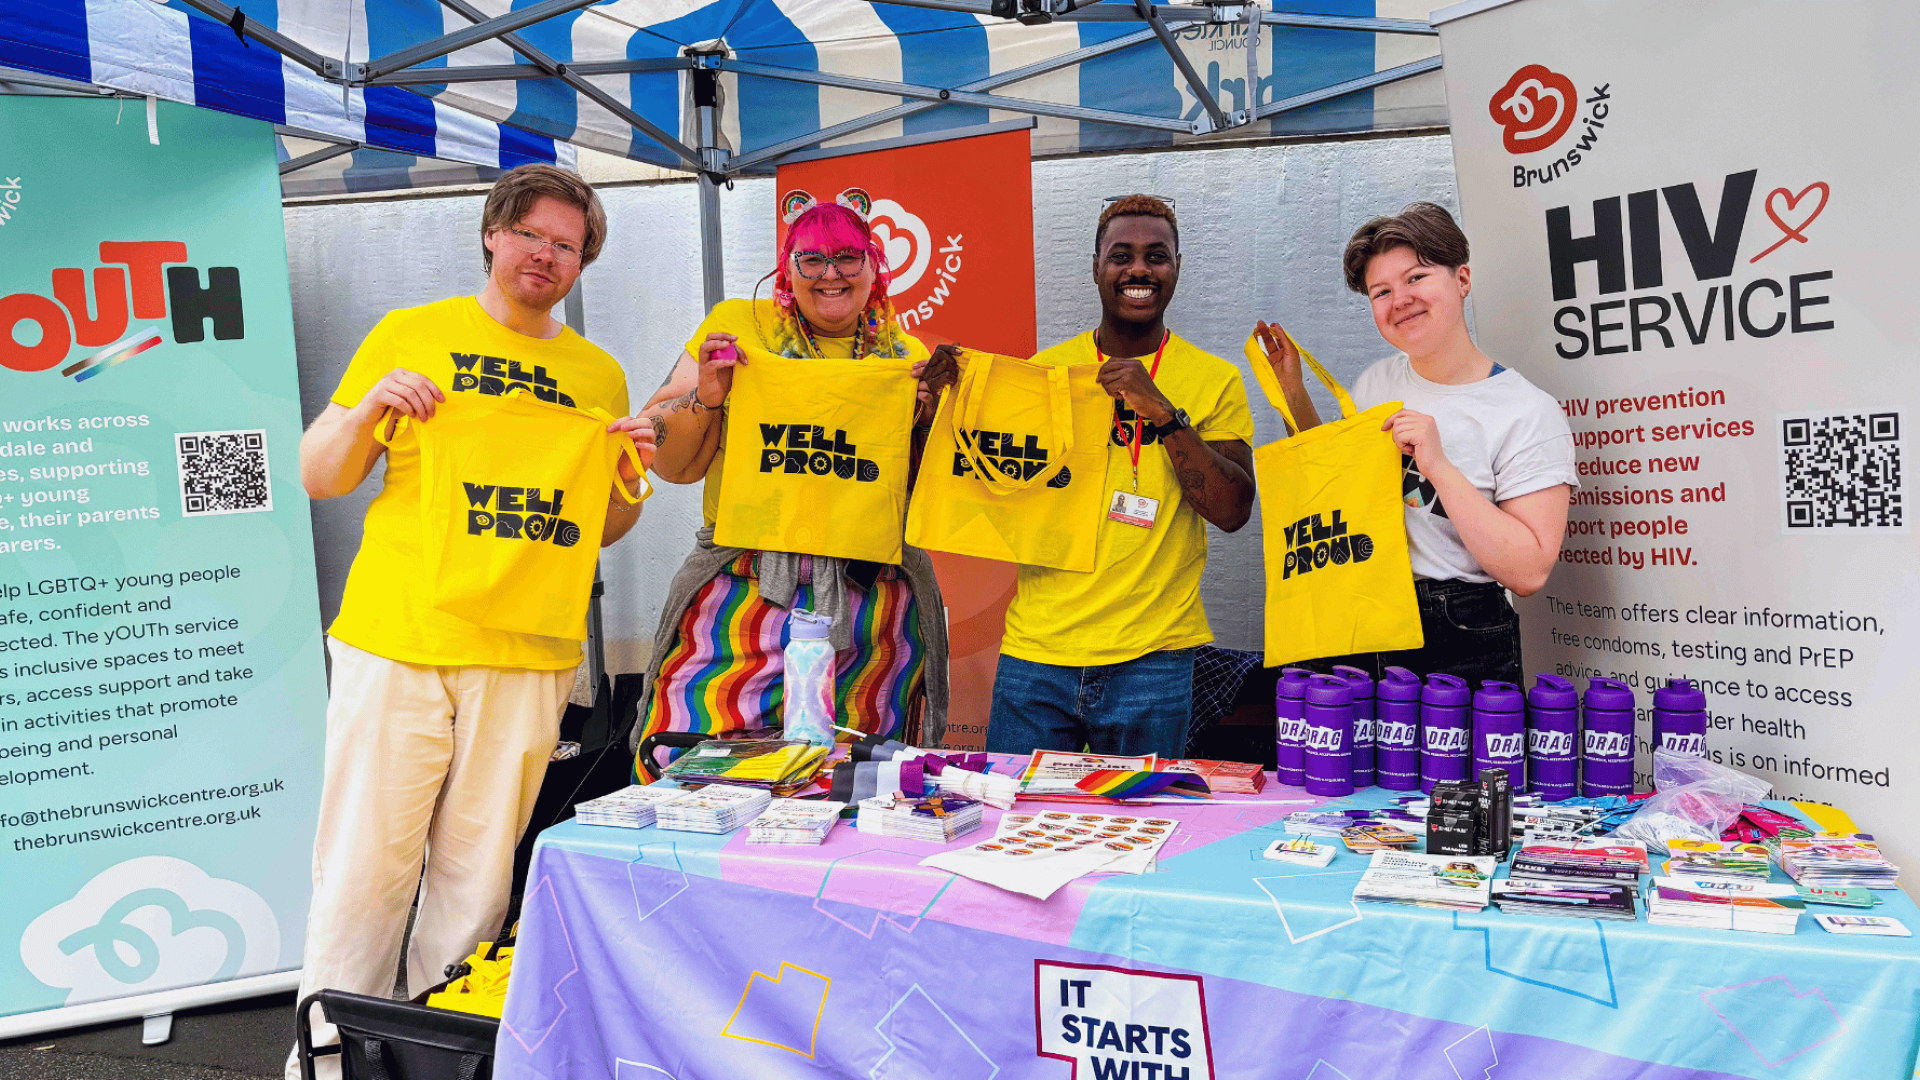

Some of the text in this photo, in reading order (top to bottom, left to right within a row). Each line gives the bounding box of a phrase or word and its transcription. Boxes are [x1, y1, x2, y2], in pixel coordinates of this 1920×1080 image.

[1512, 82, 1611, 188] Brunswick
[1545, 168, 1758, 302] HIV
[1552, 270, 1836, 360] SERVICE
[449, 352, 558, 390] WELL
[1557, 387, 1726, 419] HIV prevention
[2, 413, 150, 433] works across
[1572, 418, 1755, 451] upport services
[51, 438, 93, 455] and
[759, 423, 857, 457] WELL
[29, 459, 150, 481] supporting
[759, 448, 880, 483] PROUD
[1573, 452, 1700, 478] educe new
[21, 487, 91, 507] young
[462, 482, 565, 516] WELL
[1680, 482, 1726, 504] and
[18, 509, 72, 528] their
[77, 506, 161, 527] parents
[467, 510, 581, 548] PROUD
[1283, 509, 1348, 551] WELL
[1610, 515, 1689, 539] people
[1283, 533, 1374, 580] PROUD
[1617, 547, 1645, 570] by
[1651, 547, 1698, 567] HIV.
[27, 575, 109, 597] LGBTQ+
[115, 571, 174, 592] young
[179, 564, 241, 584] people
[38, 600, 132, 622] confident
[137, 596, 172, 612] and
[1546, 595, 1886, 636] The team offers clear information,
[62, 631, 99, 646] The
[104, 623, 169, 646] yOUTh
[174, 617, 240, 635] service
[14, 658, 98, 679] inclusive
[104, 651, 169, 670] spaces
[173, 647, 193, 661] to
[198, 641, 245, 659] meet
[1550, 628, 1854, 670] free condoms, testing and PrEP
[26, 684, 94, 703] access
[98, 674, 172, 695] support
[177, 669, 210, 687] and
[215, 664, 254, 683] take
[1609, 666, 1640, 688] and
[1645, 671, 1741, 700] guance
[1747, 678, 1769, 699] to
[1774, 684, 1853, 708] access
[1, 694, 239, 733] in activities that promote
[1281, 721, 1307, 738] DRA
[1740, 713, 1807, 741] health
[58, 735, 93, 753] and
[98, 725, 179, 751] personal
[1530, 732, 1573, 751] DRAG
[1586, 733, 1630, 751] DRAG
[1730, 748, 1746, 768] is
[1753, 757, 1777, 773] on
[1784, 759, 1891, 788] informed
[13, 805, 262, 852] thebrunswickcentre.org.uk
[1060, 978, 1092, 1008] IT
[1061, 1013, 1192, 1059] STARTS
[1090, 1055, 1190, 1080] WITH
